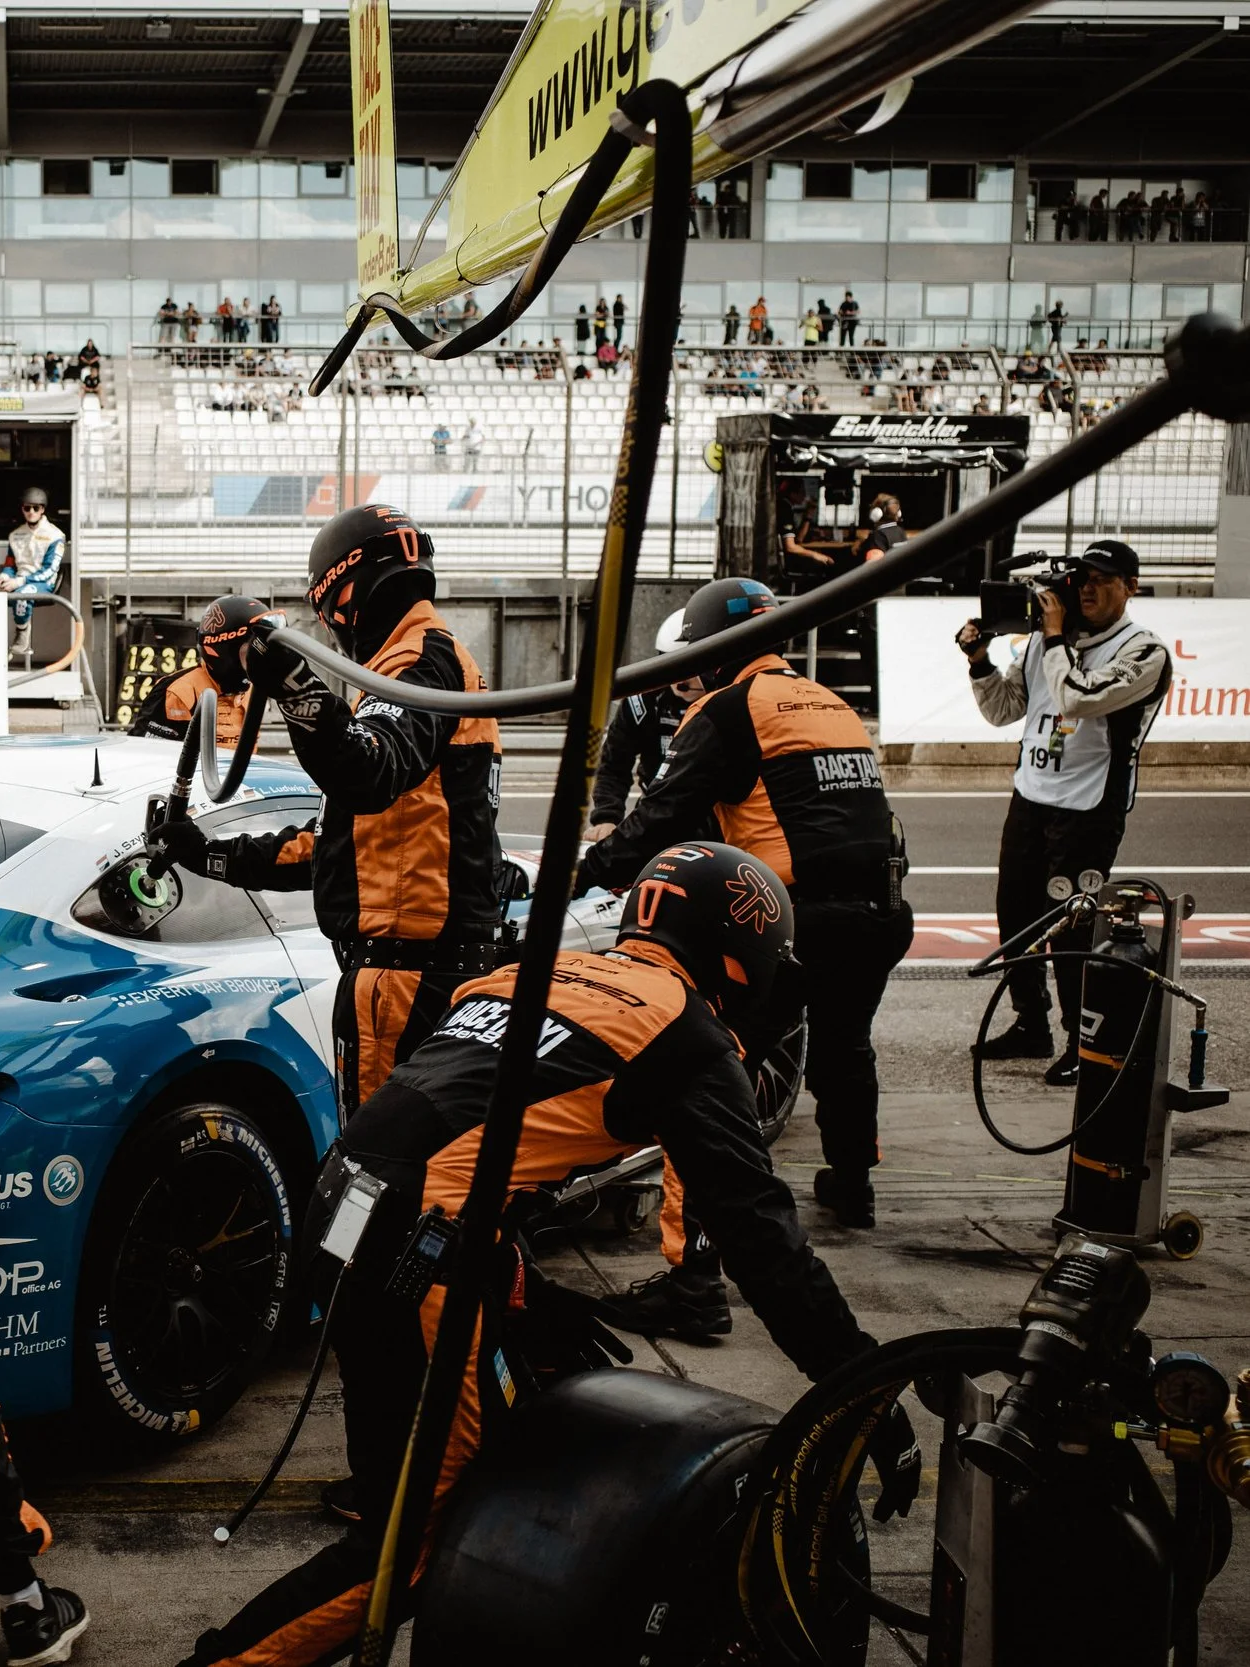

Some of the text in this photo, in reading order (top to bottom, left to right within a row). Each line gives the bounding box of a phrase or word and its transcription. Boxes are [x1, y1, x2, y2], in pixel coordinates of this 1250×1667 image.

[359, 105, 381, 240] TAXI
[829, 416, 968, 438] Schmickler
[873, 437, 961, 446] PERFORMANCE
[270, 784, 306, 794] Ludwig
[121, 832, 148, 851] Szy
[656, 863, 677, 872] Max
[134, 978, 283, 1006] EXPERT CAR BROKER
[236, 1126, 291, 1226] MICHELIN
[22, 1280, 62, 1295] office AG
[13, 1335, 67, 1357] Partners
[95, 1341, 169, 1431] MICHELIN
[793, 1407, 847, 1472] paoli pit stop
